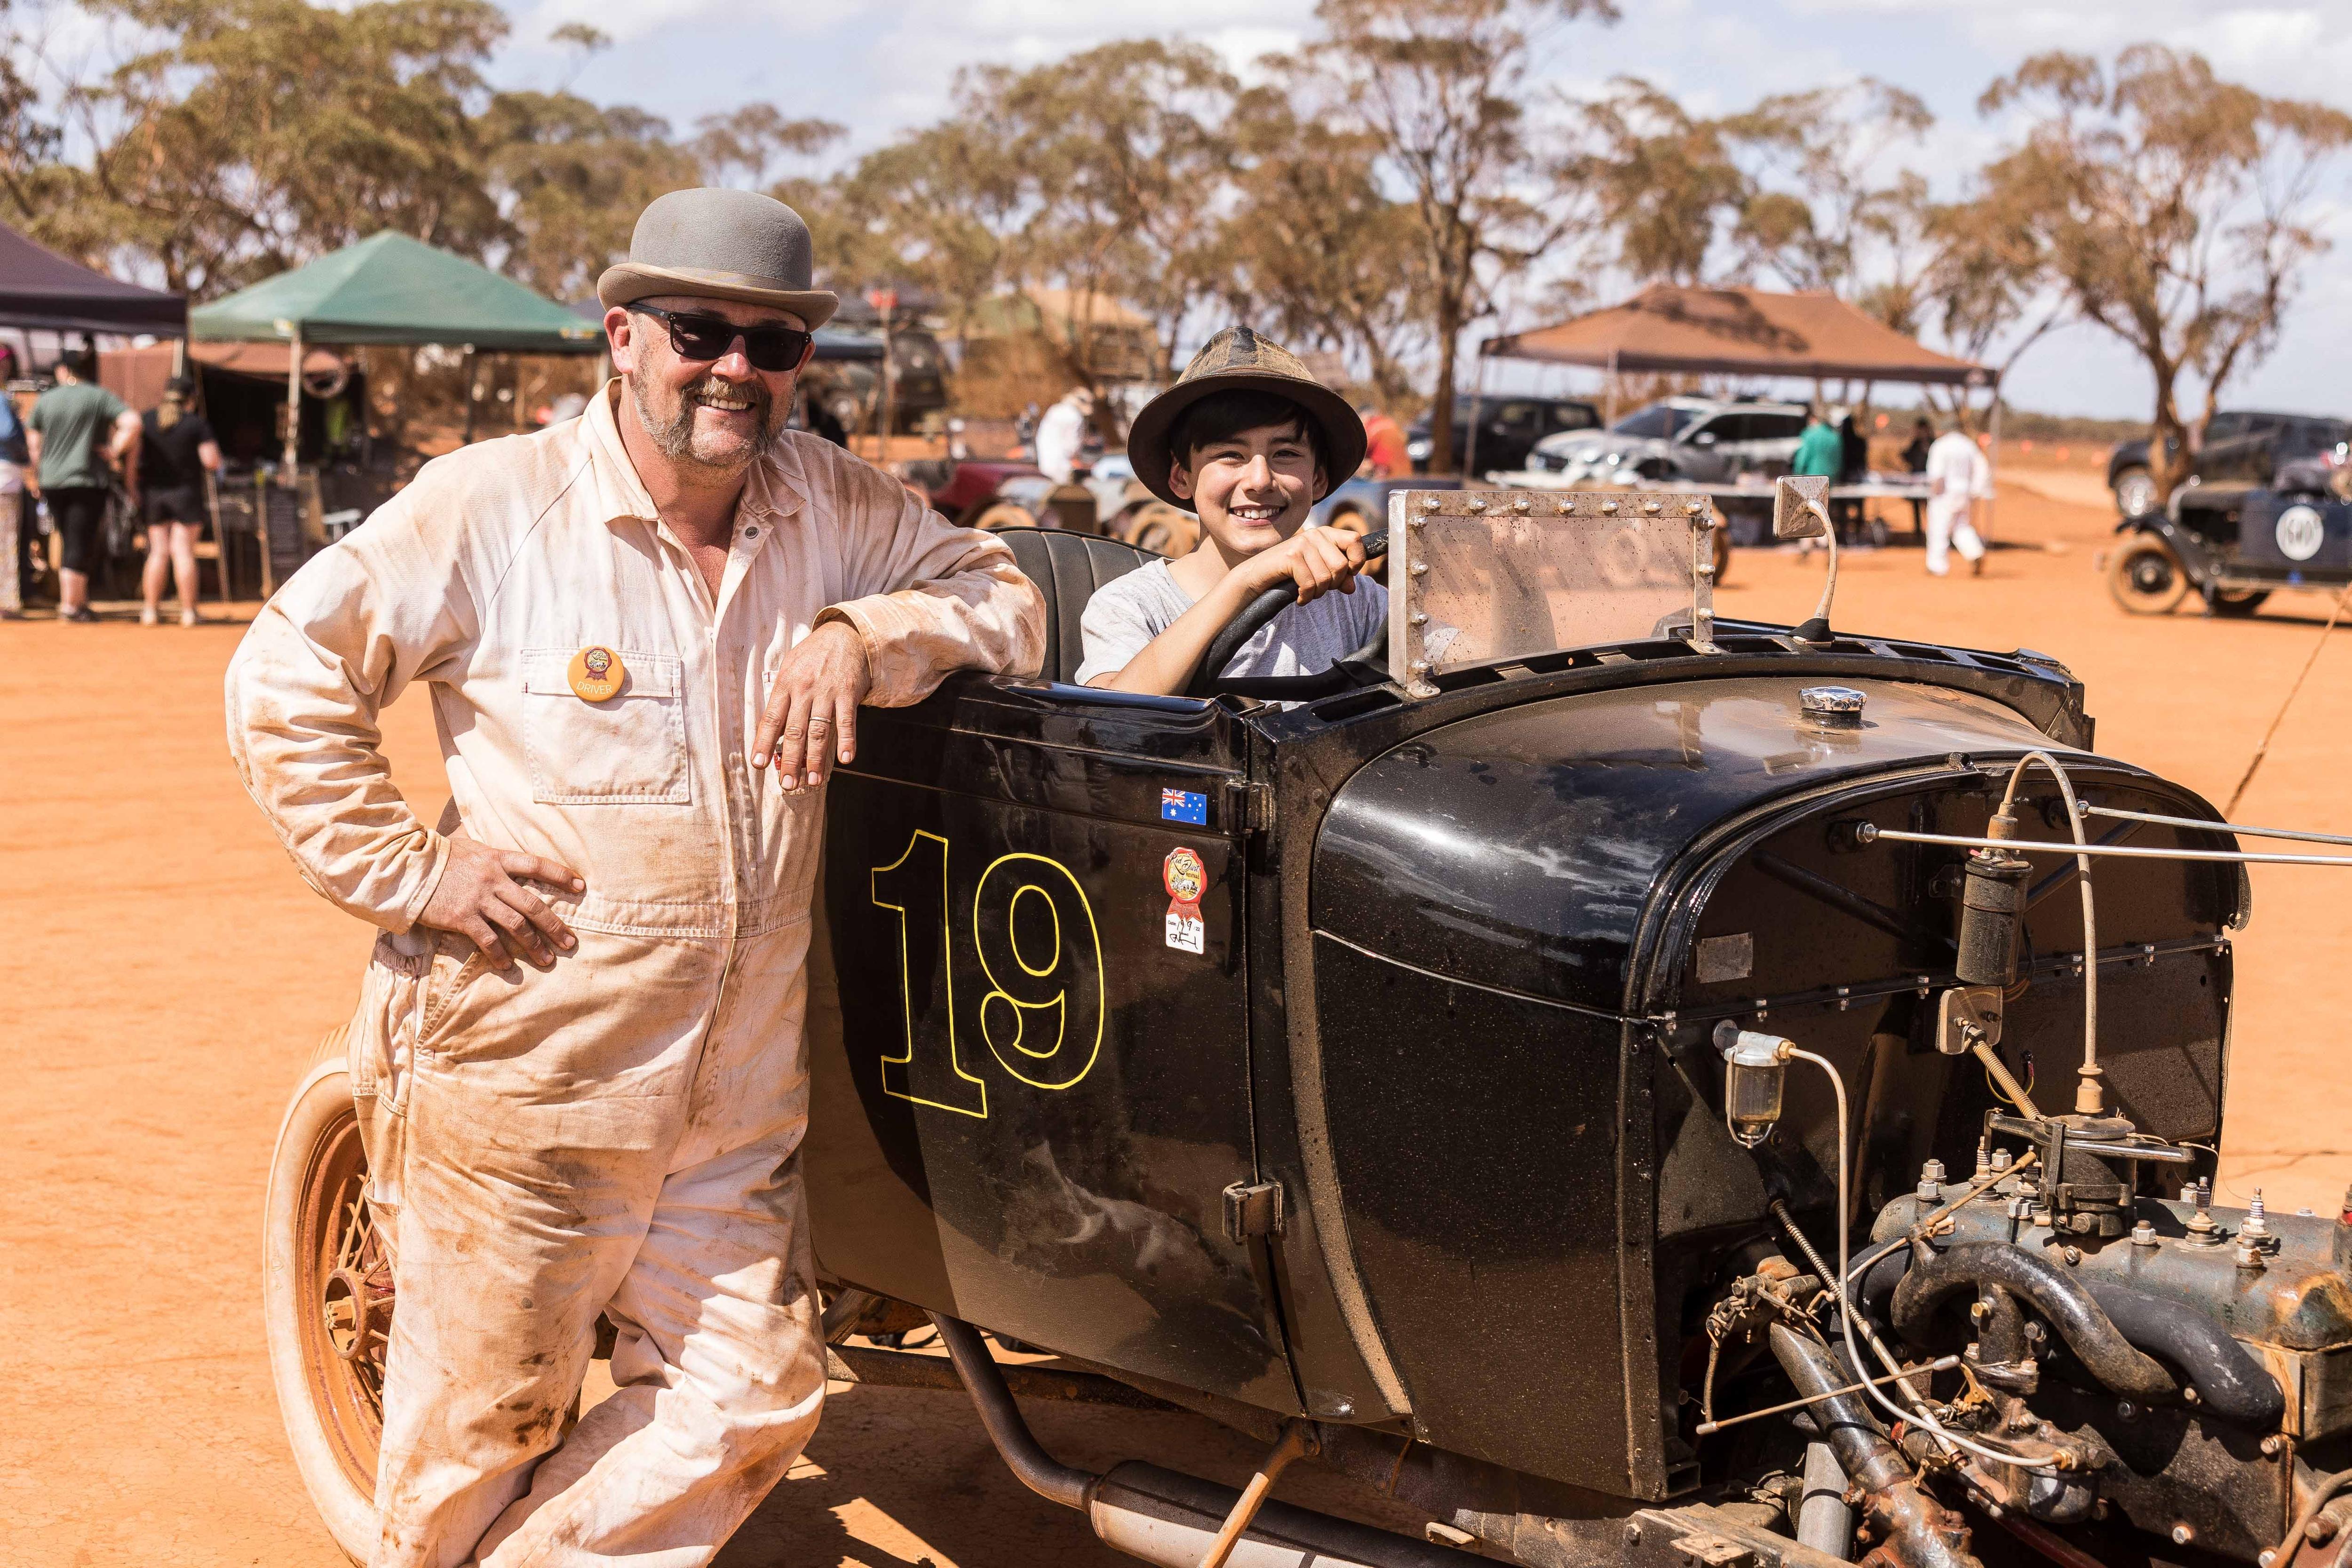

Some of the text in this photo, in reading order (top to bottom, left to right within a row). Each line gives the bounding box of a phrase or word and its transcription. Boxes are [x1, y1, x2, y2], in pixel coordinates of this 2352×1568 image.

[576, 681, 612, 694] DRIVER
[1169, 851, 1201, 876] Red Dust
[872, 829, 1105, 1119] 19
